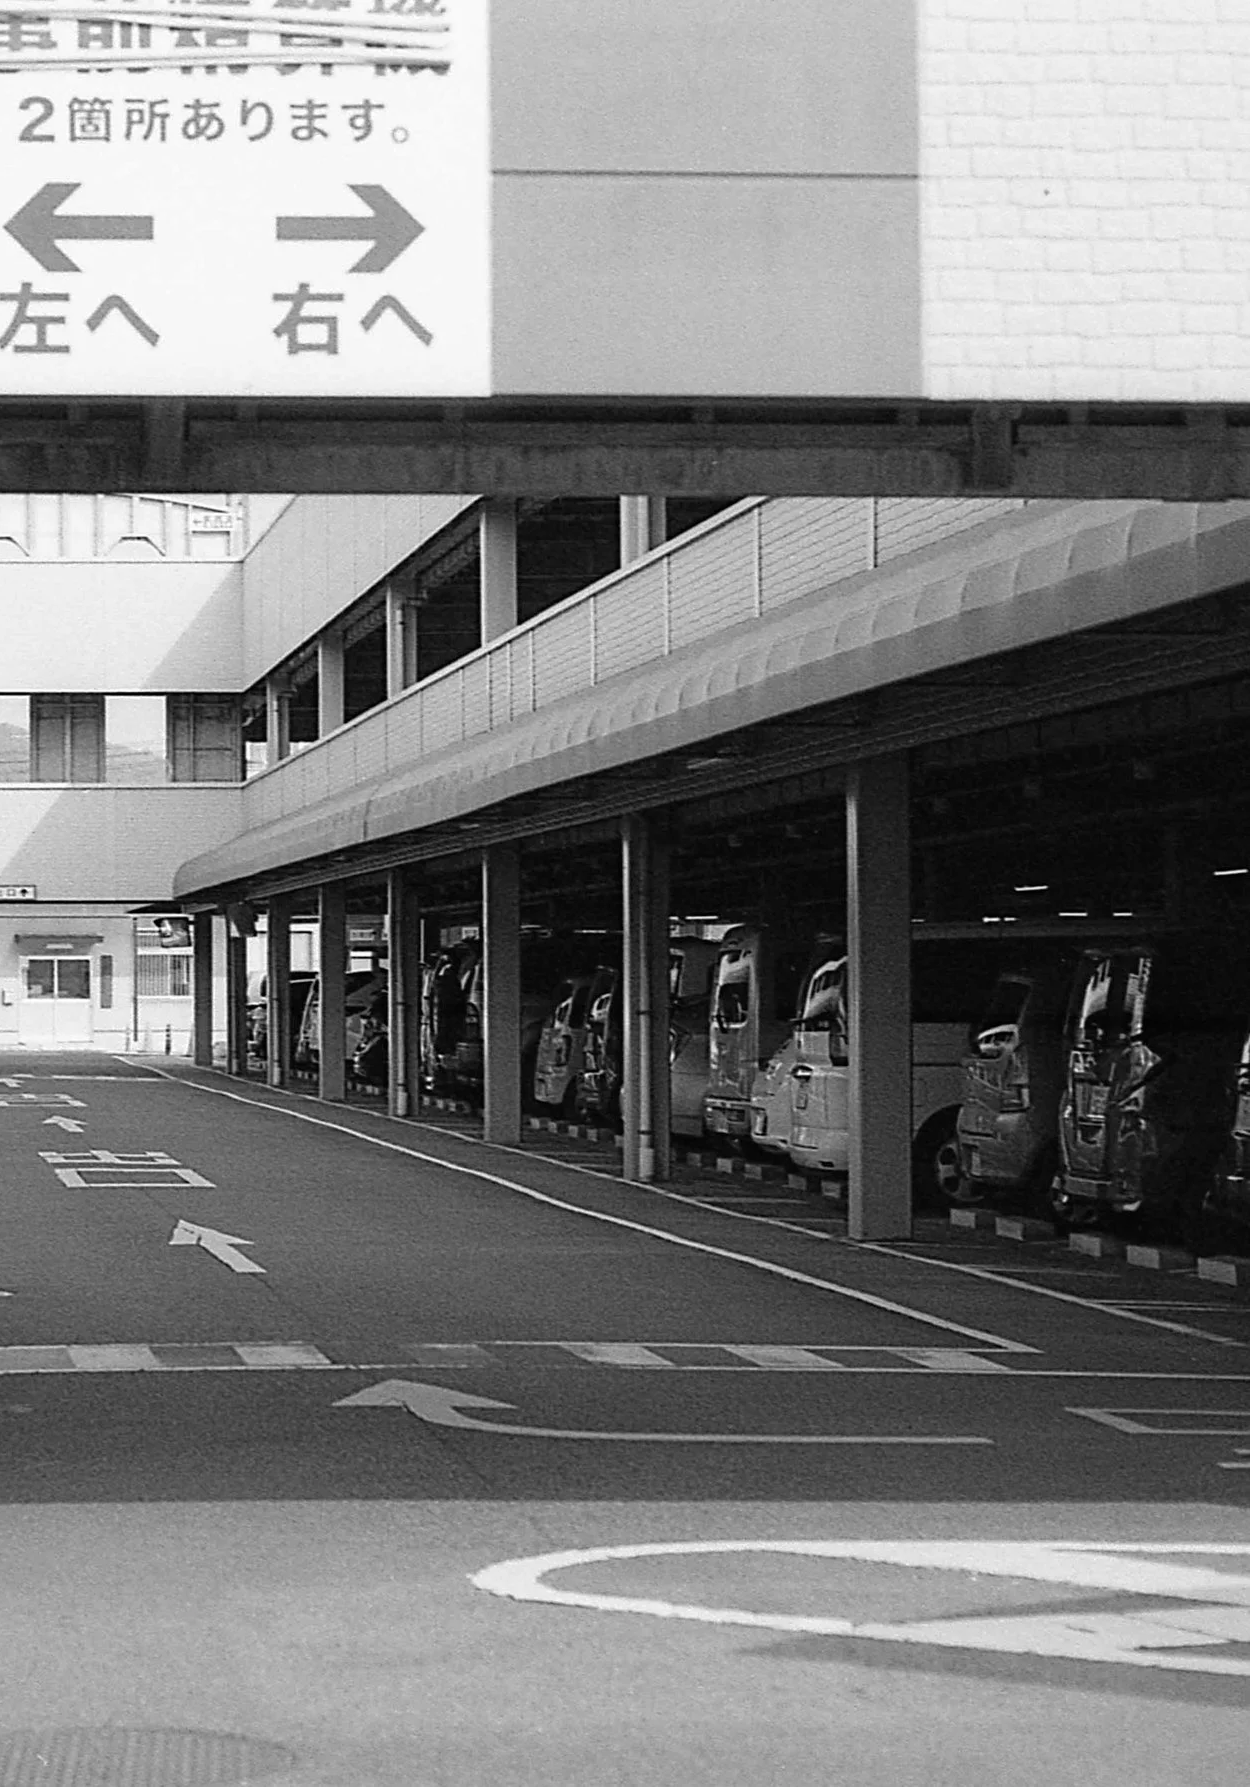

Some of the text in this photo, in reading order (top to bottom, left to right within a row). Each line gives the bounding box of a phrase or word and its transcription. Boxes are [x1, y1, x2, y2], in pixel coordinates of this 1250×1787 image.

[18, 96, 410, 143] 2箇所あります。
[272, 283, 433, 355] 右へ
[38, 1150, 217, 1188] 出口
